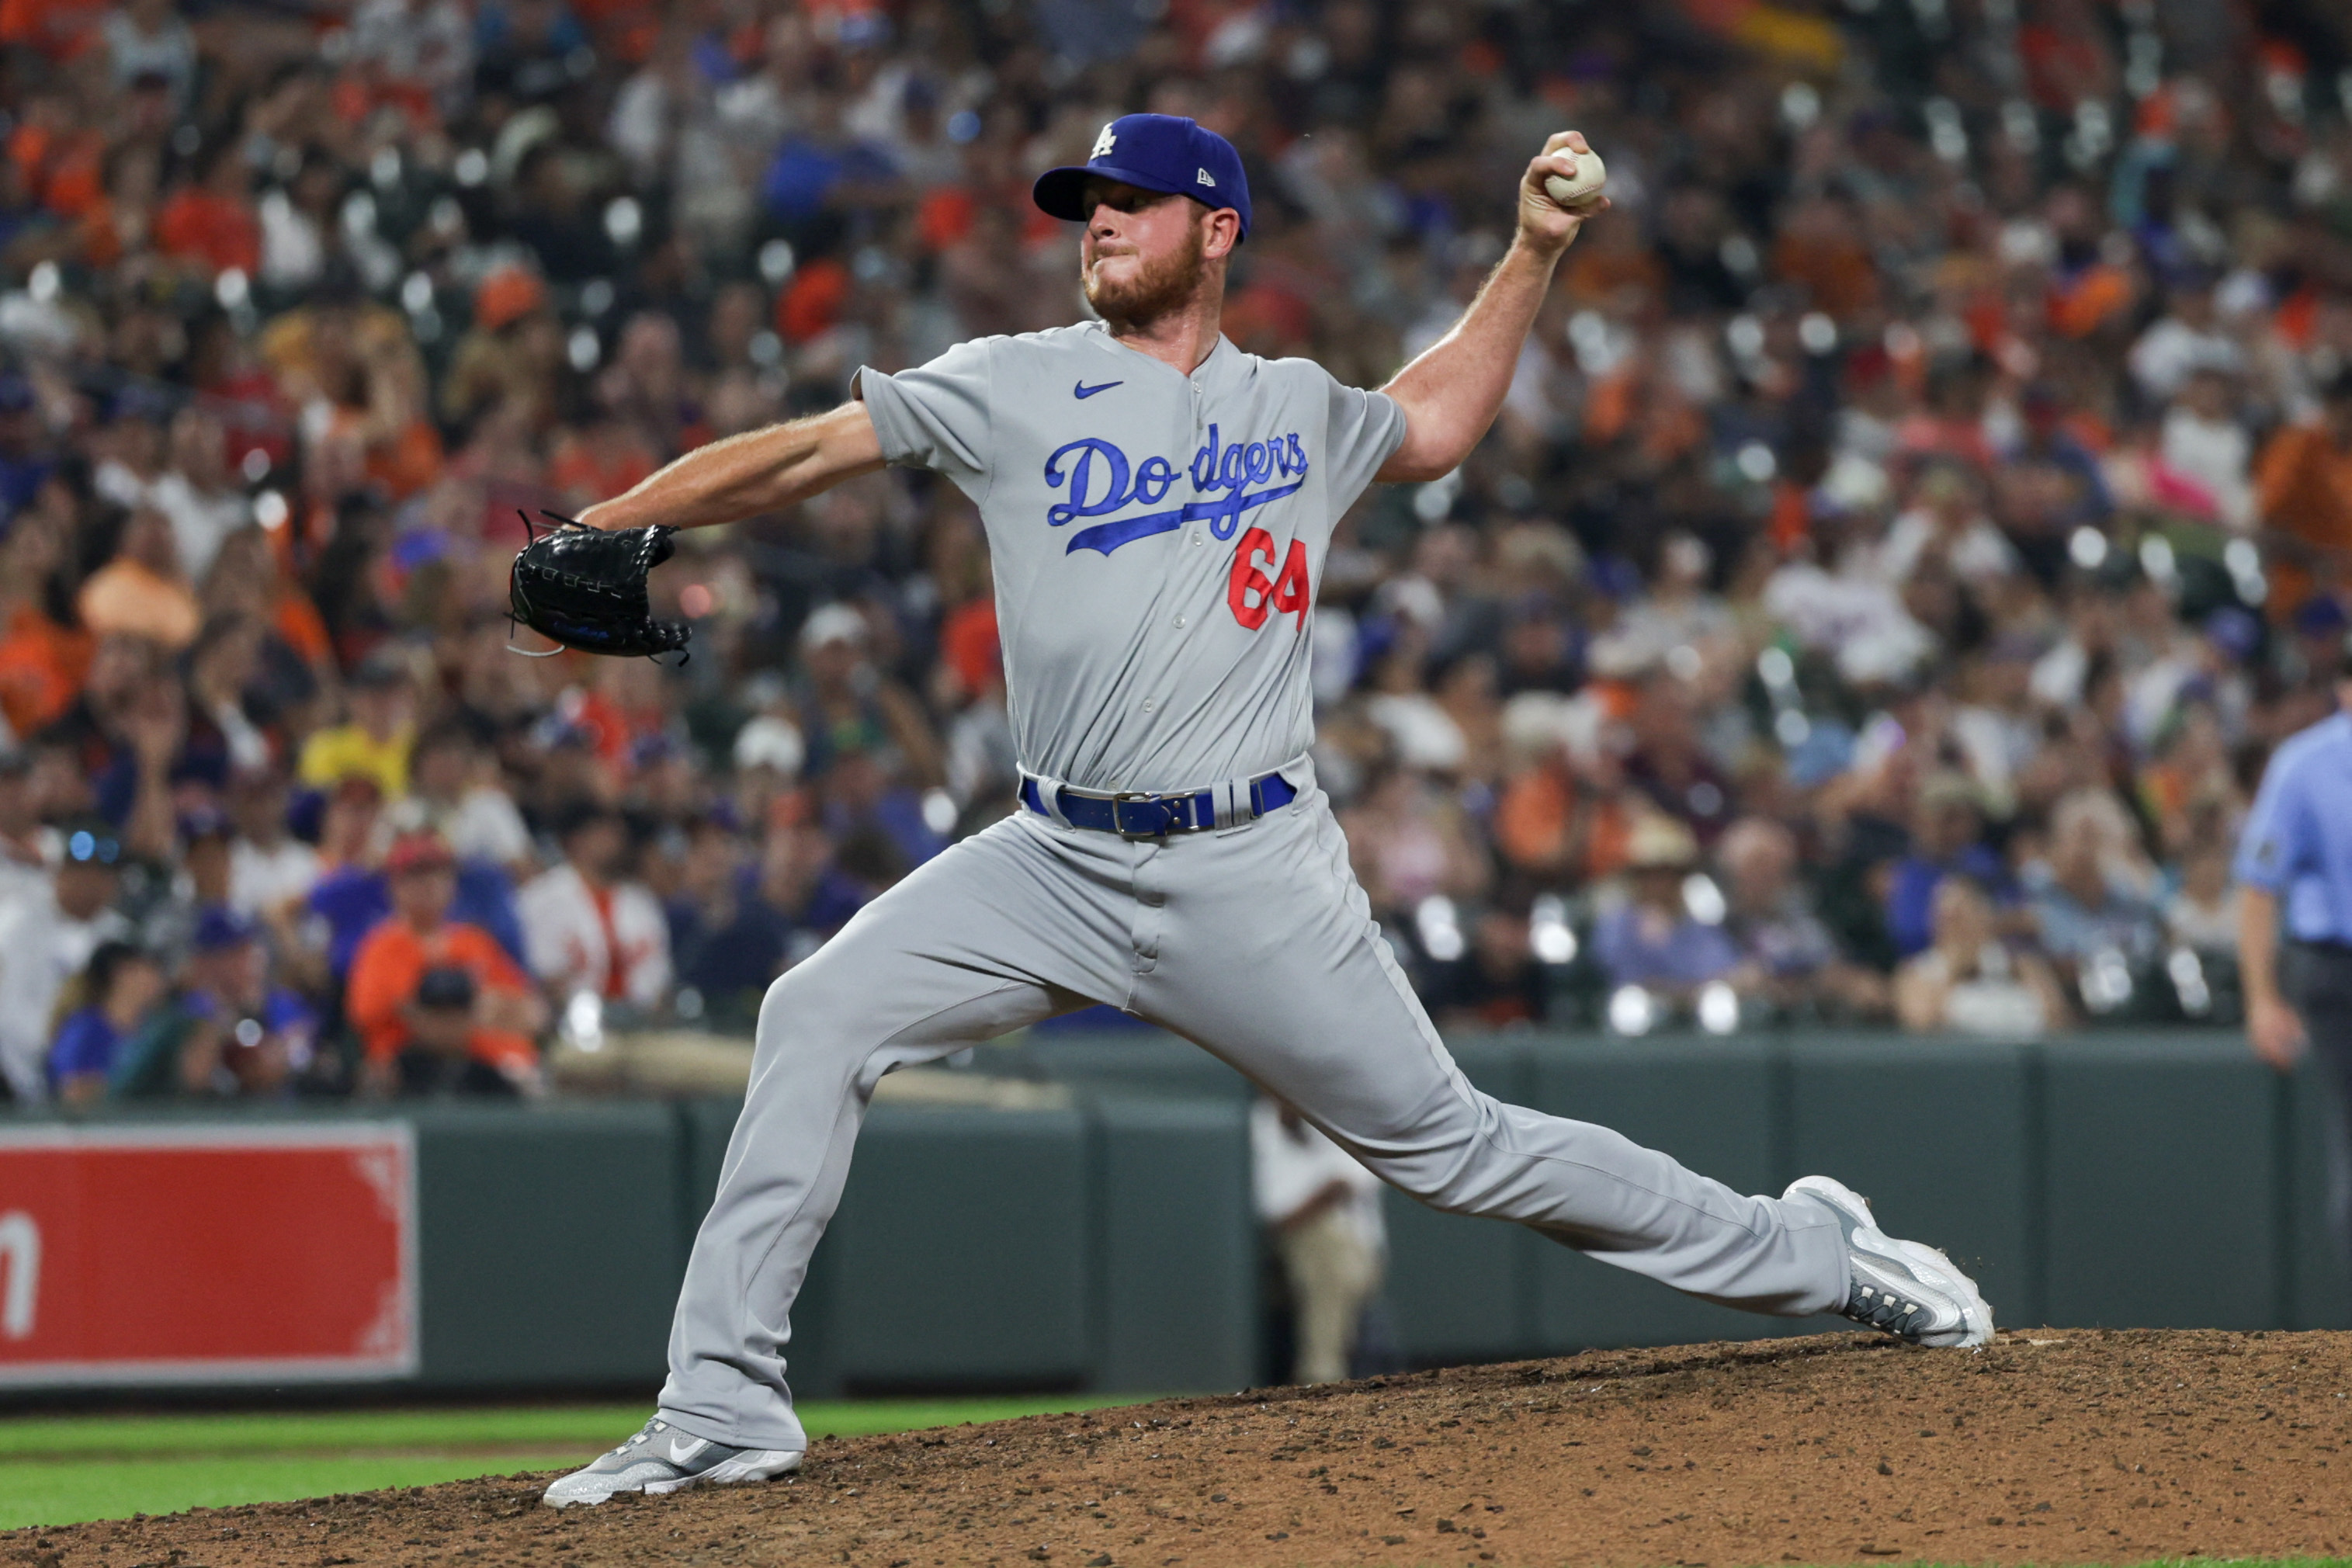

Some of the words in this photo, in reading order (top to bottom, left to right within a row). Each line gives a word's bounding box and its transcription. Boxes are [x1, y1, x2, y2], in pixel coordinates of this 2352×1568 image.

[1090, 122, 1116, 159] LA
[1045, 423, 1309, 541] Dodgers
[1228, 527, 1310, 631] 64
